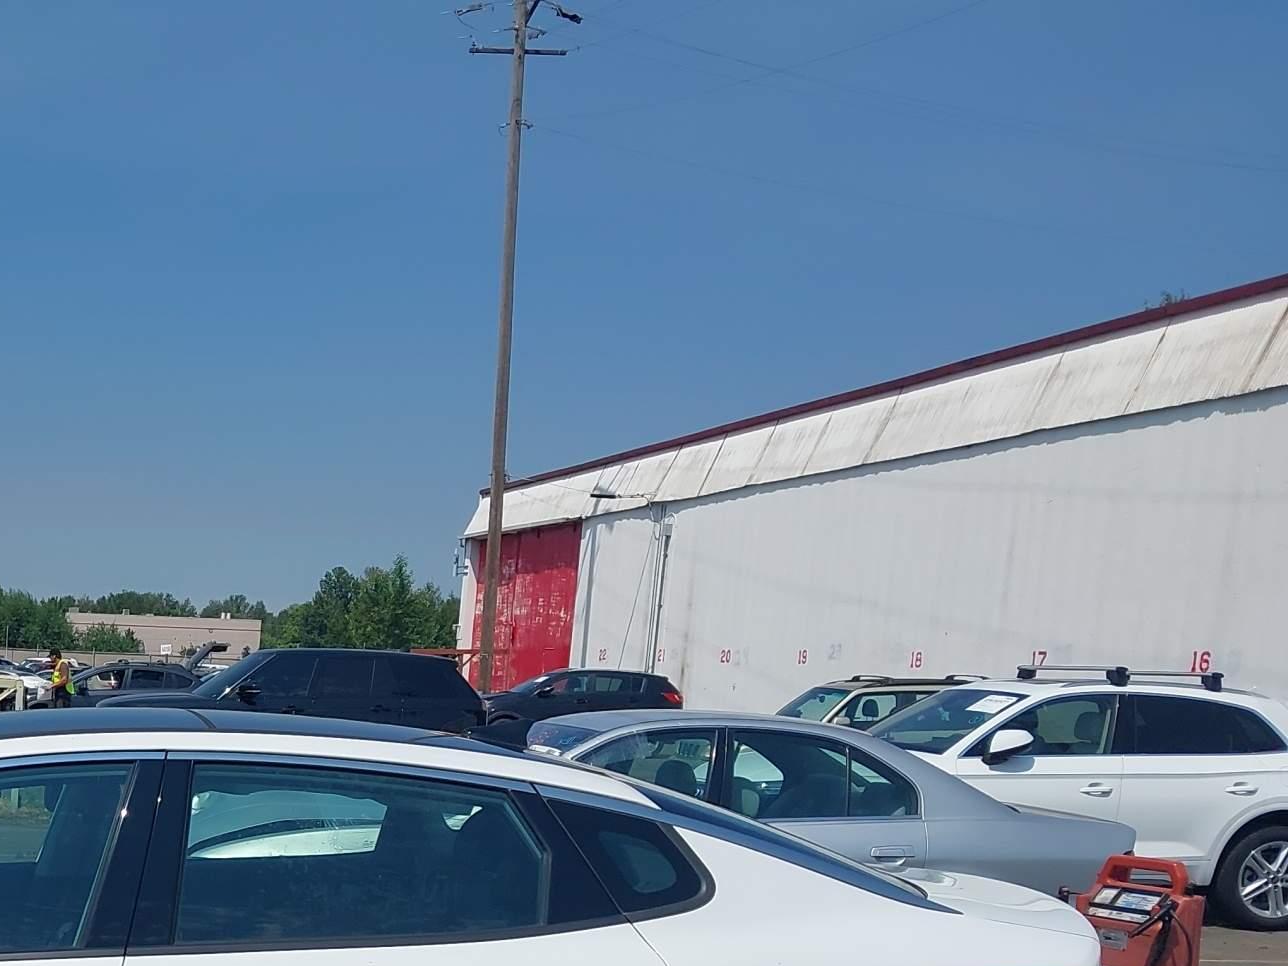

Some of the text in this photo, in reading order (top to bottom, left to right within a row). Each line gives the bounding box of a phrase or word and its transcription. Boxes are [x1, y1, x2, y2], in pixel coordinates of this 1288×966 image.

[598, 648, 607, 661] 22
[657, 648, 666, 662] 21
[720, 649, 731, 663] 20
[797, 649, 808, 665] 19
[910, 651, 923, 668] 18
[1032, 651, 1047, 666] 17
[1191, 650, 1211, 673] 16
